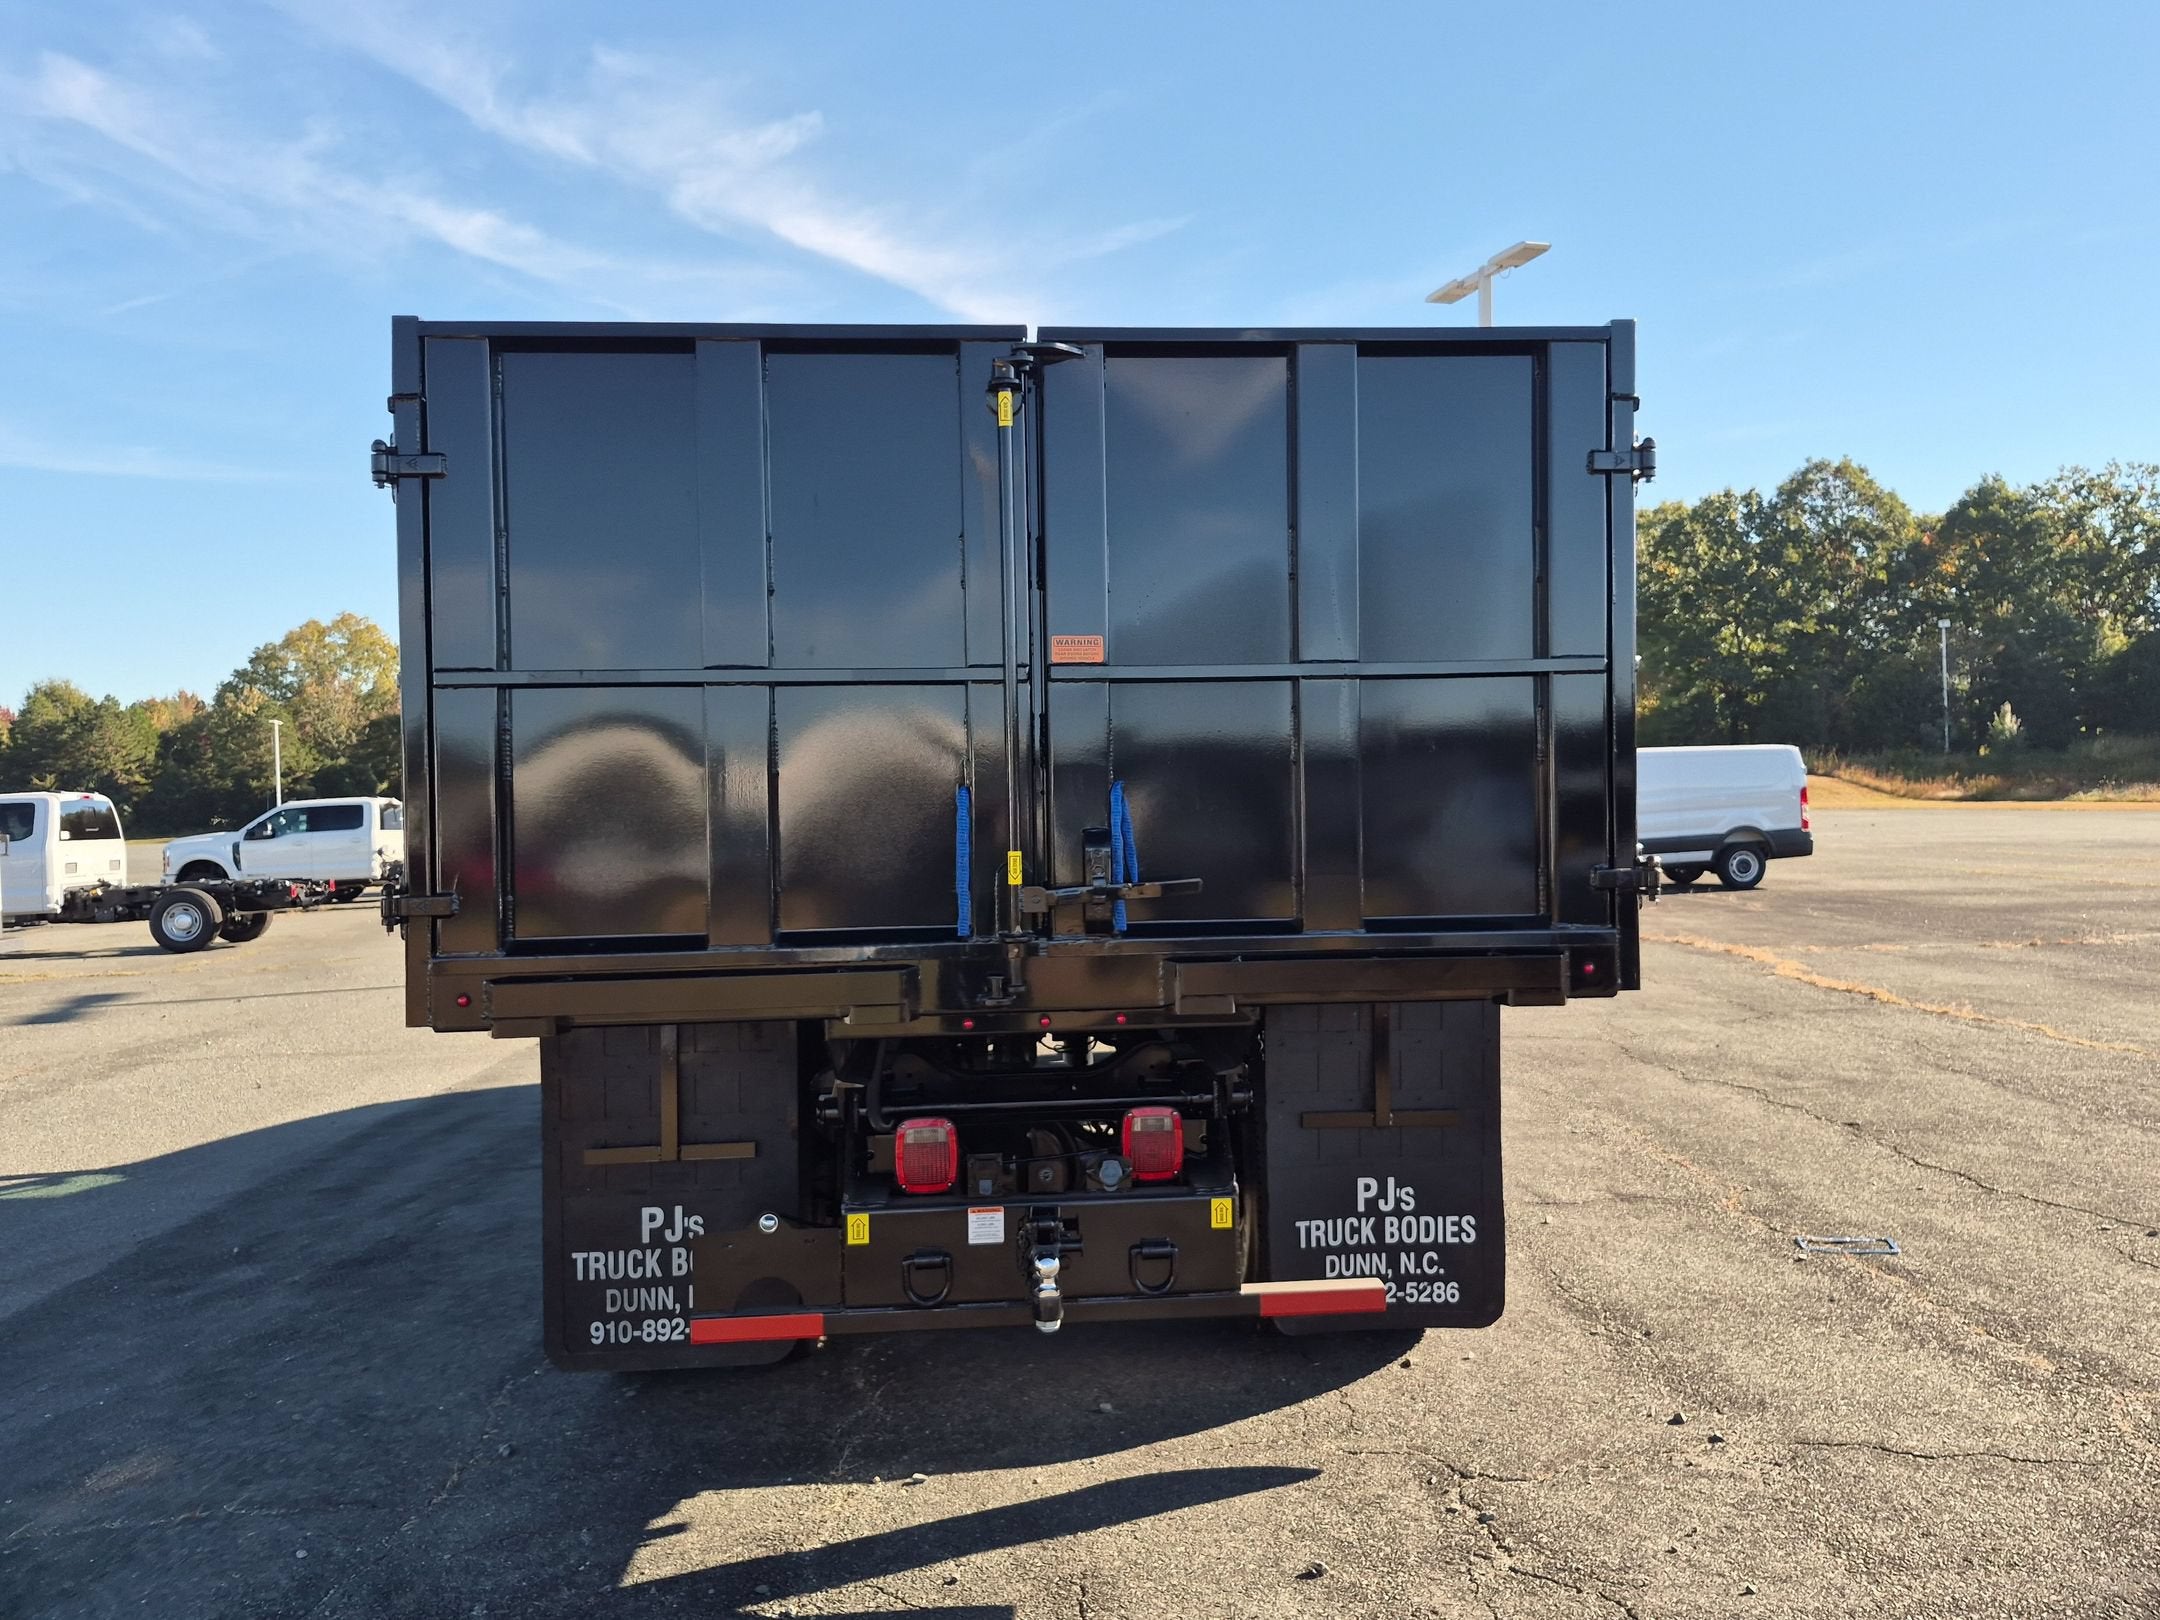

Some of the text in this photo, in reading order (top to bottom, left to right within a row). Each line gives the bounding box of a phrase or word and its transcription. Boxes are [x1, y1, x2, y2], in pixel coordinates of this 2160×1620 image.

[1357, 1176, 1416, 1212] PJ's
[1295, 1214, 1476, 1248] TRUCK BODIES
[571, 1248, 663, 1281] TRUCK
[1325, 1251, 1445, 1278] DUNN, N.C.
[606, 1285, 681, 1314] DUNN,
